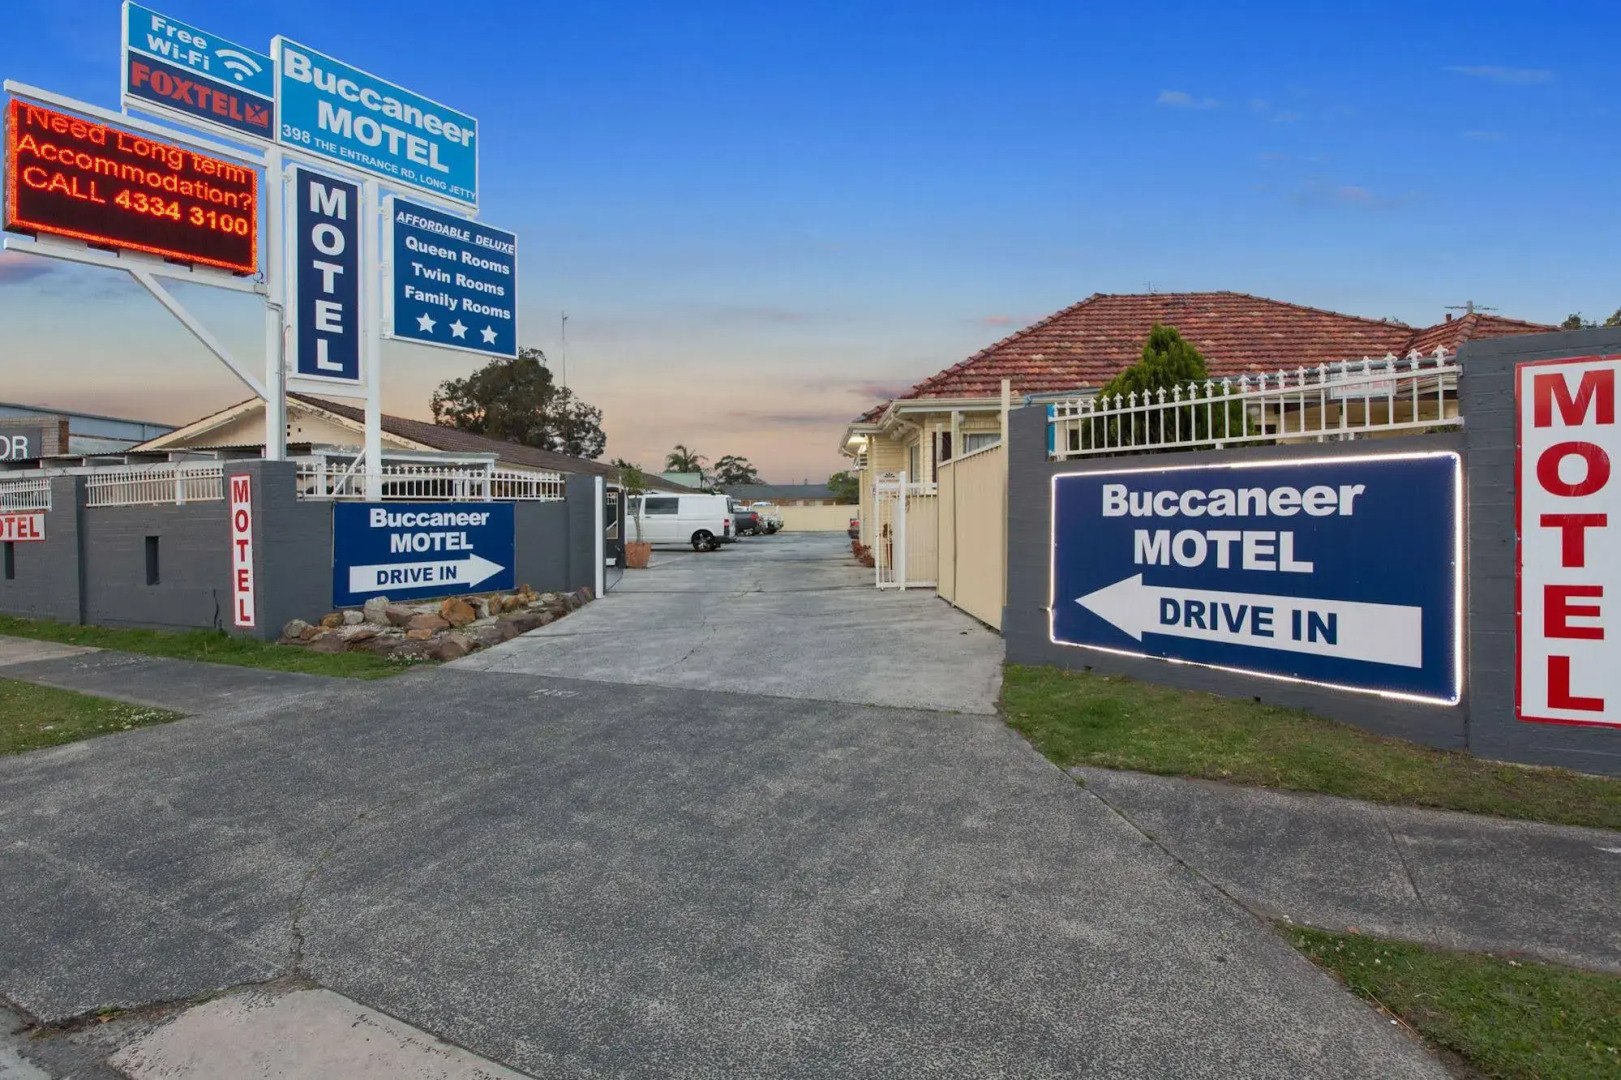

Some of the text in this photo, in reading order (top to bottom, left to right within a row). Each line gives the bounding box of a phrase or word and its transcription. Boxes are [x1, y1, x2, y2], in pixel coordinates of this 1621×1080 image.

[147, 33, 209, 71] Wi-Fi
[152, 15, 207, 49] Free
[132, 61, 243, 121] FOXTEL
[284, 48, 474, 147] Buccaneer
[26, 105, 246, 184] Need Long term
[318, 100, 449, 173] MOTEL
[17, 133, 252, 211] Accommodation?
[282, 124, 476, 200] 398 THE ENTRANCE RD, LONG JETTY
[23, 166, 249, 236] CALL 4334 3100
[396, 211, 515, 254] AFFORDABLE DELUXE
[405, 236, 510, 275] Queen Rooms
[310, 181, 347, 372] MOTEL
[412, 262, 505, 297] Twin Rooms
[404, 285, 511, 320] Family Rooms
[369, 508, 490, 528] Buccaneer
[1102, 484, 1366, 517] Buccaneer
[233, 480, 250, 622] MOTEL
[391, 531, 474, 554] MOTEL
[1134, 529, 1314, 573] MOTEL
[1533, 368, 1616, 713] MOTEL
[377, 565, 457, 586] DRIVE IN
[1159, 597, 1337, 645] DRIVE IN
